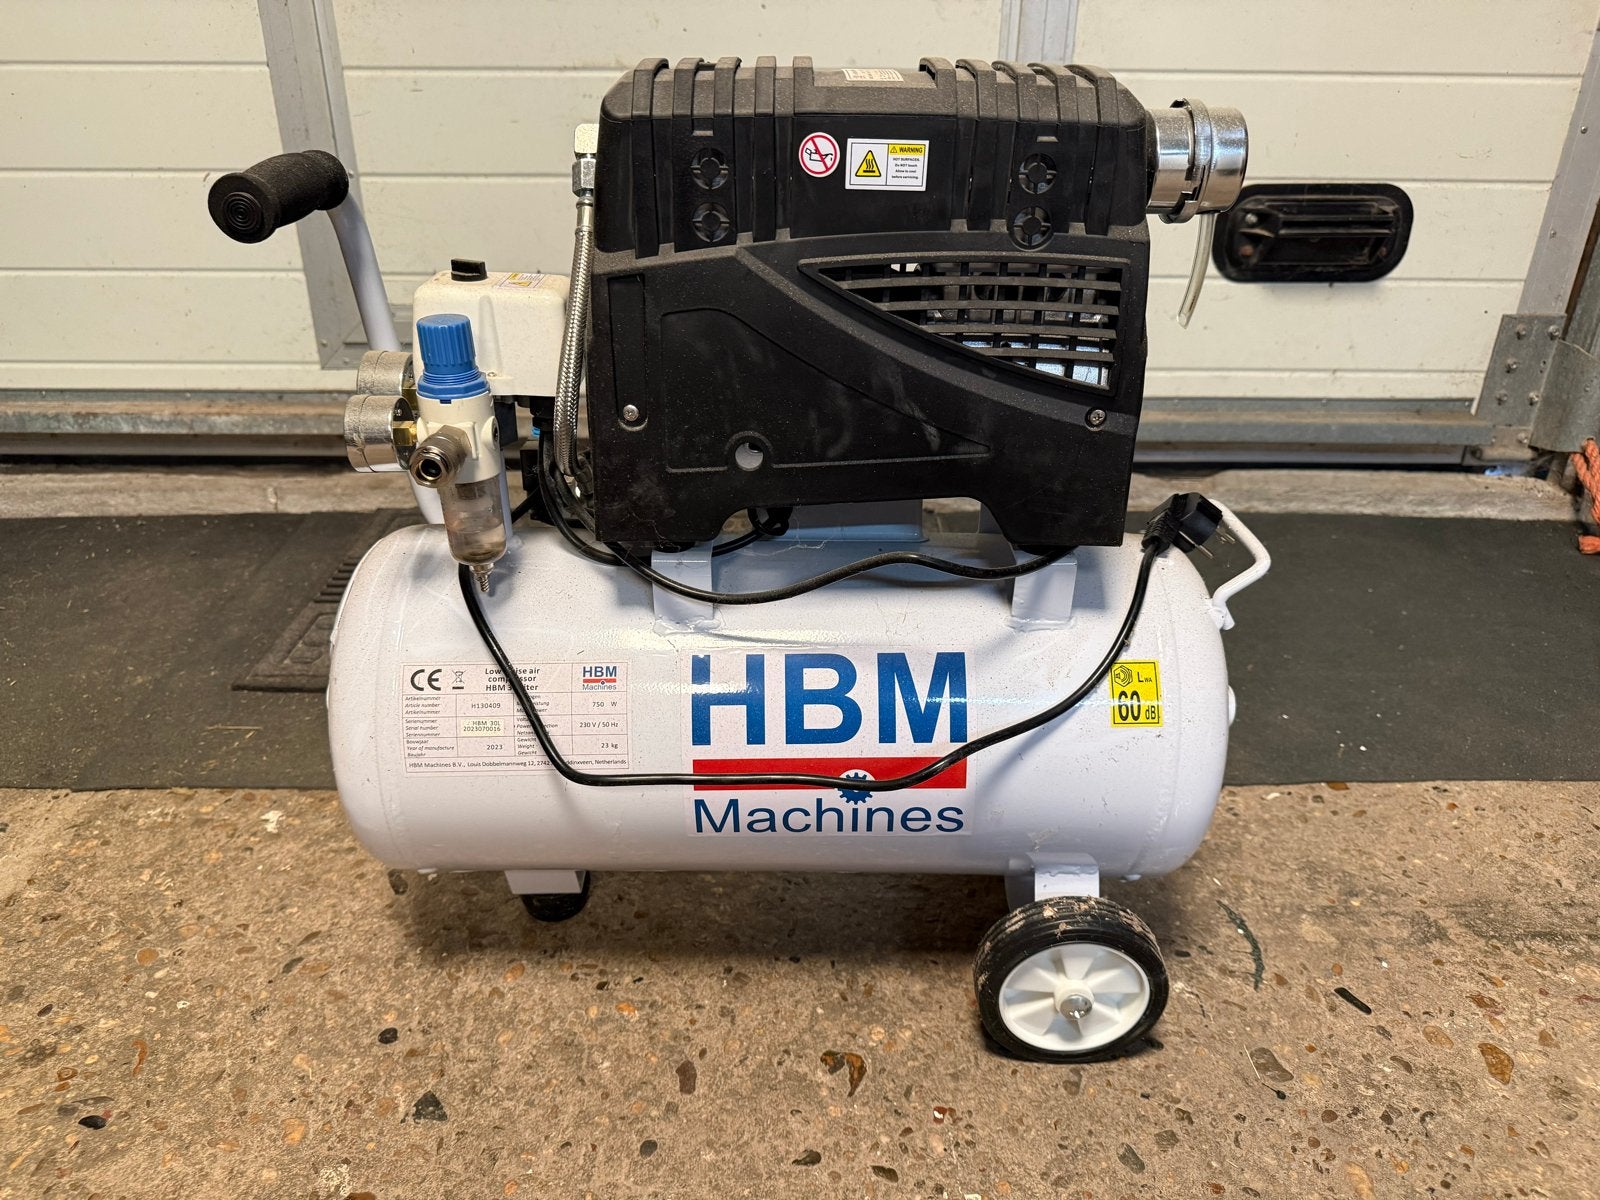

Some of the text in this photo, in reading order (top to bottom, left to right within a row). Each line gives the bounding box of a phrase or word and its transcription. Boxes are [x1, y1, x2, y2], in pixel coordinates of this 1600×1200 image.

[583, 666, 617, 677] HBM
[692, 652, 968, 746] HBM
[1118, 690, 1156, 721] 60 dB
[694, 798, 964, 833] Machines
